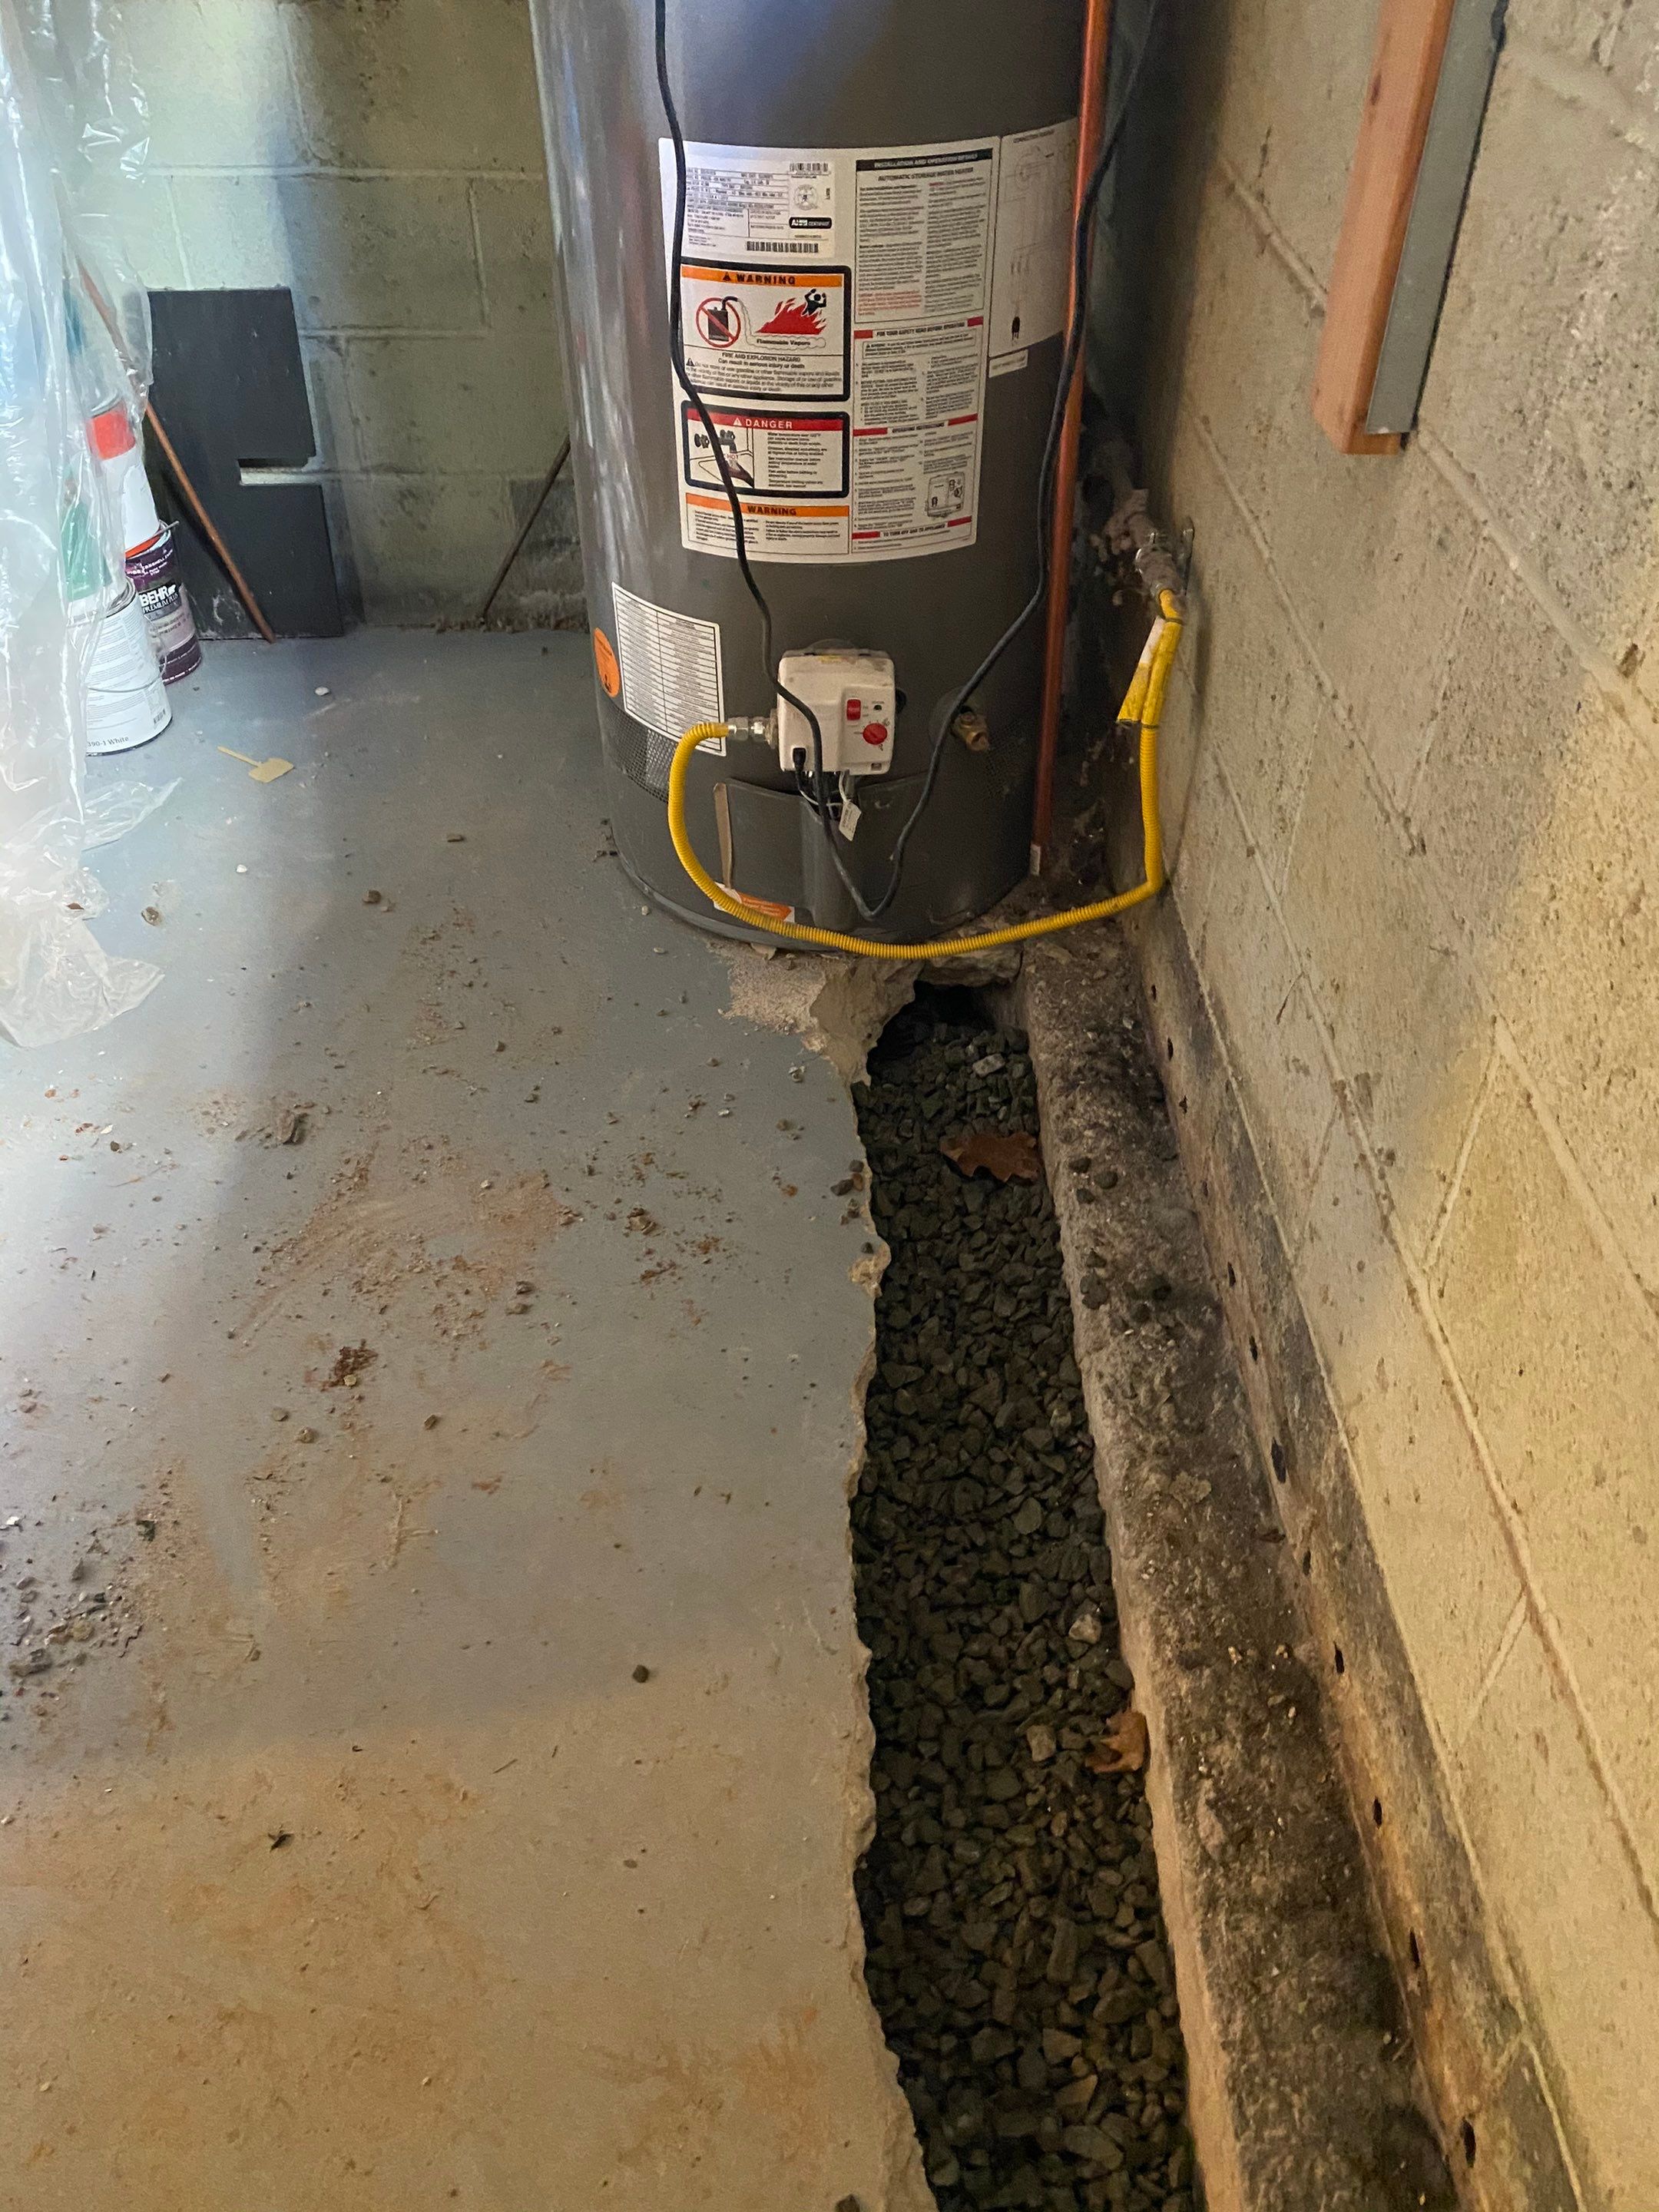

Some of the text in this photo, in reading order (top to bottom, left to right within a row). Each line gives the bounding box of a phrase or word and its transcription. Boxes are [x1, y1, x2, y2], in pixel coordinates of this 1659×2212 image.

[736, 273, 796, 285] WARNING
[745, 418, 793, 429] DANGER
[747, 505, 797, 516] WARNING
[139, 585, 169, 608] BEHR
[142, 599, 169, 614] PREMIUM
[108, 737, 129, 745] White
